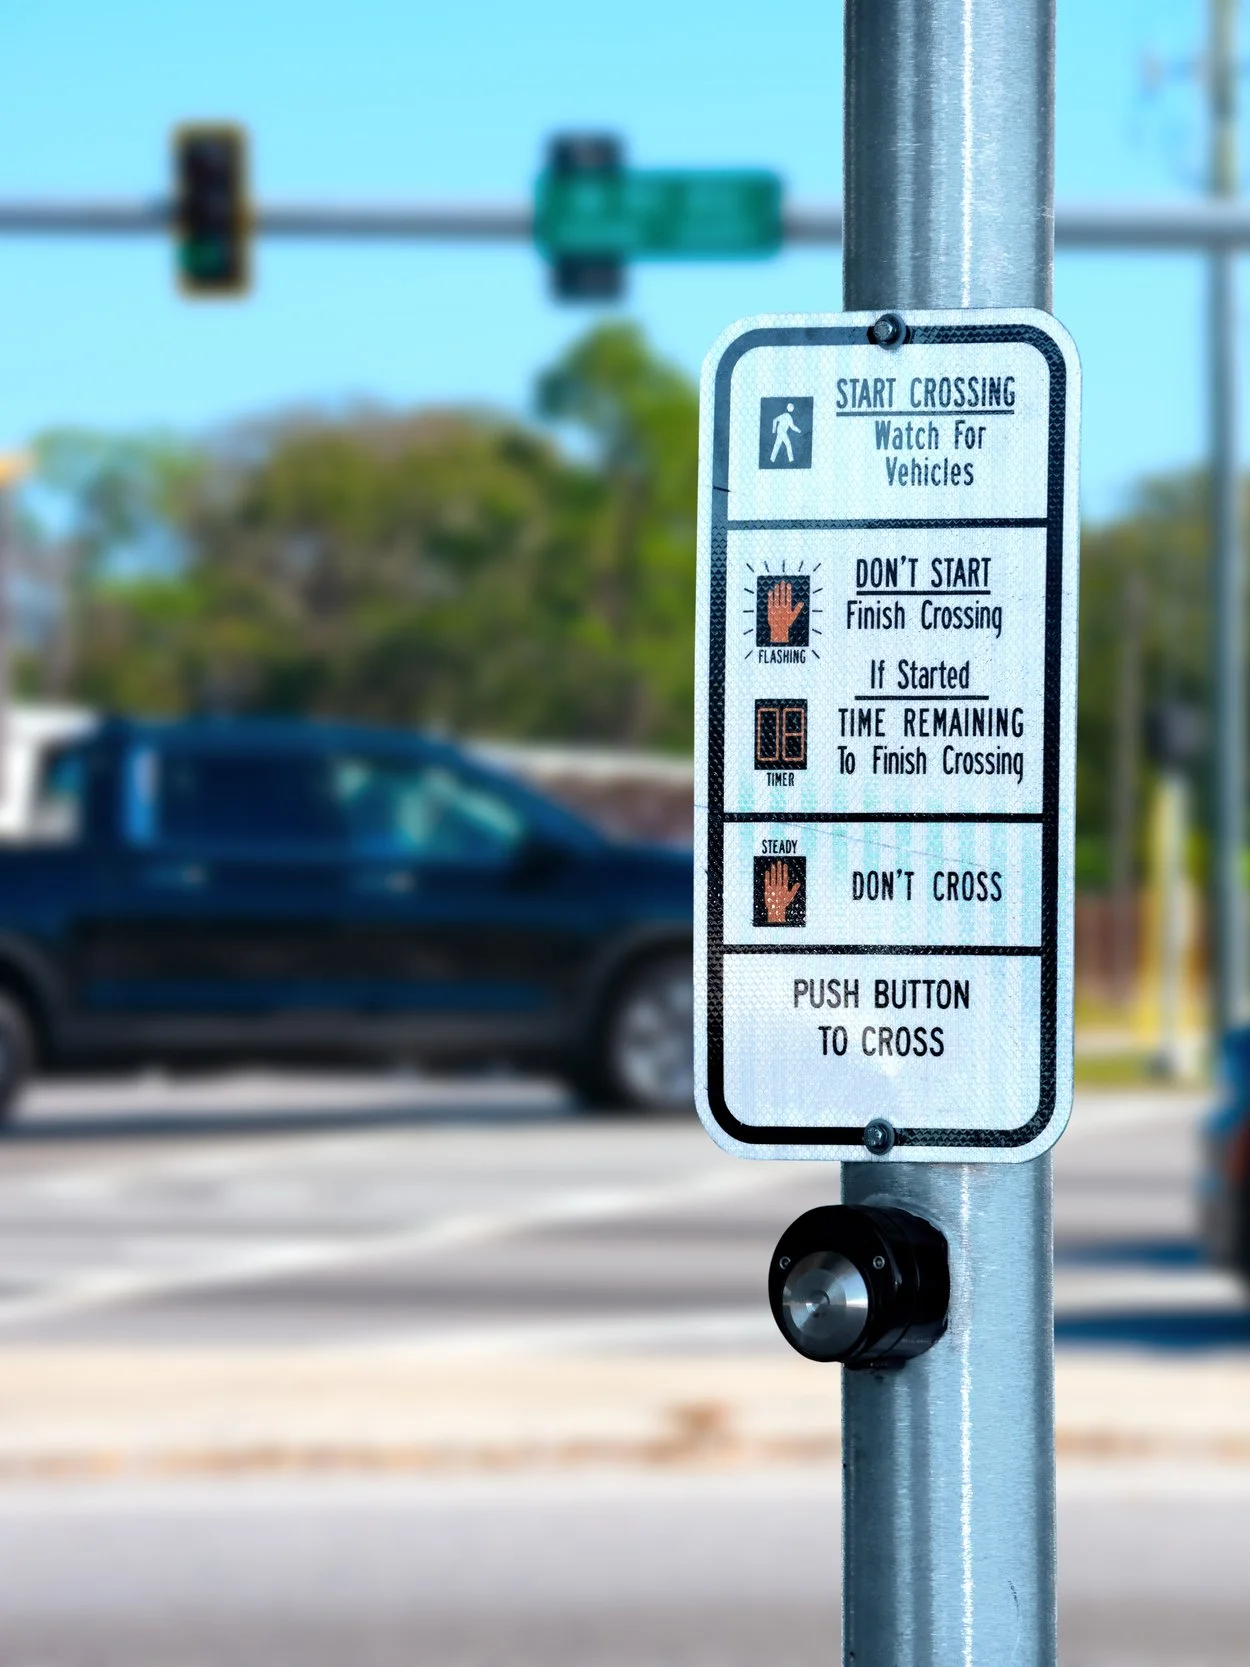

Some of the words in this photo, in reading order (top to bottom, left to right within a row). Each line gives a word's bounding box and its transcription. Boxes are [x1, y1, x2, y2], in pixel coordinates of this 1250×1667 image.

[836, 377, 896, 409] START
[911, 376, 1016, 407] CROSSING
[875, 421, 940, 450] Watch
[954, 419, 987, 449] For
[885, 457, 974, 486] Vehicles
[856, 555, 918, 587] DON'T
[931, 558, 991, 587] START
[846, 600, 905, 629] Finish
[921, 600, 1002, 638] Crossing
[758, 650, 806, 663] FLASHING
[870, 660, 885, 689] If
[897, 660, 970, 689] Started
[838, 708, 886, 737] TIME
[904, 708, 1024, 737] REMAINING
[766, 772, 795, 786] TIMER
[837, 746, 856, 775] To
[872, 745, 928, 775] Finish
[942, 745, 1024, 784] Crossing
[761, 840, 798, 855] STEADY
[852, 869, 915, 901] DON'T
[933, 871, 1003, 901] CROSS
[793, 979, 860, 1008] PUSH
[874, 979, 970, 1009] BUTTON
[818, 1026, 849, 1056] TO
[861, 1027, 945, 1057] CROSS
